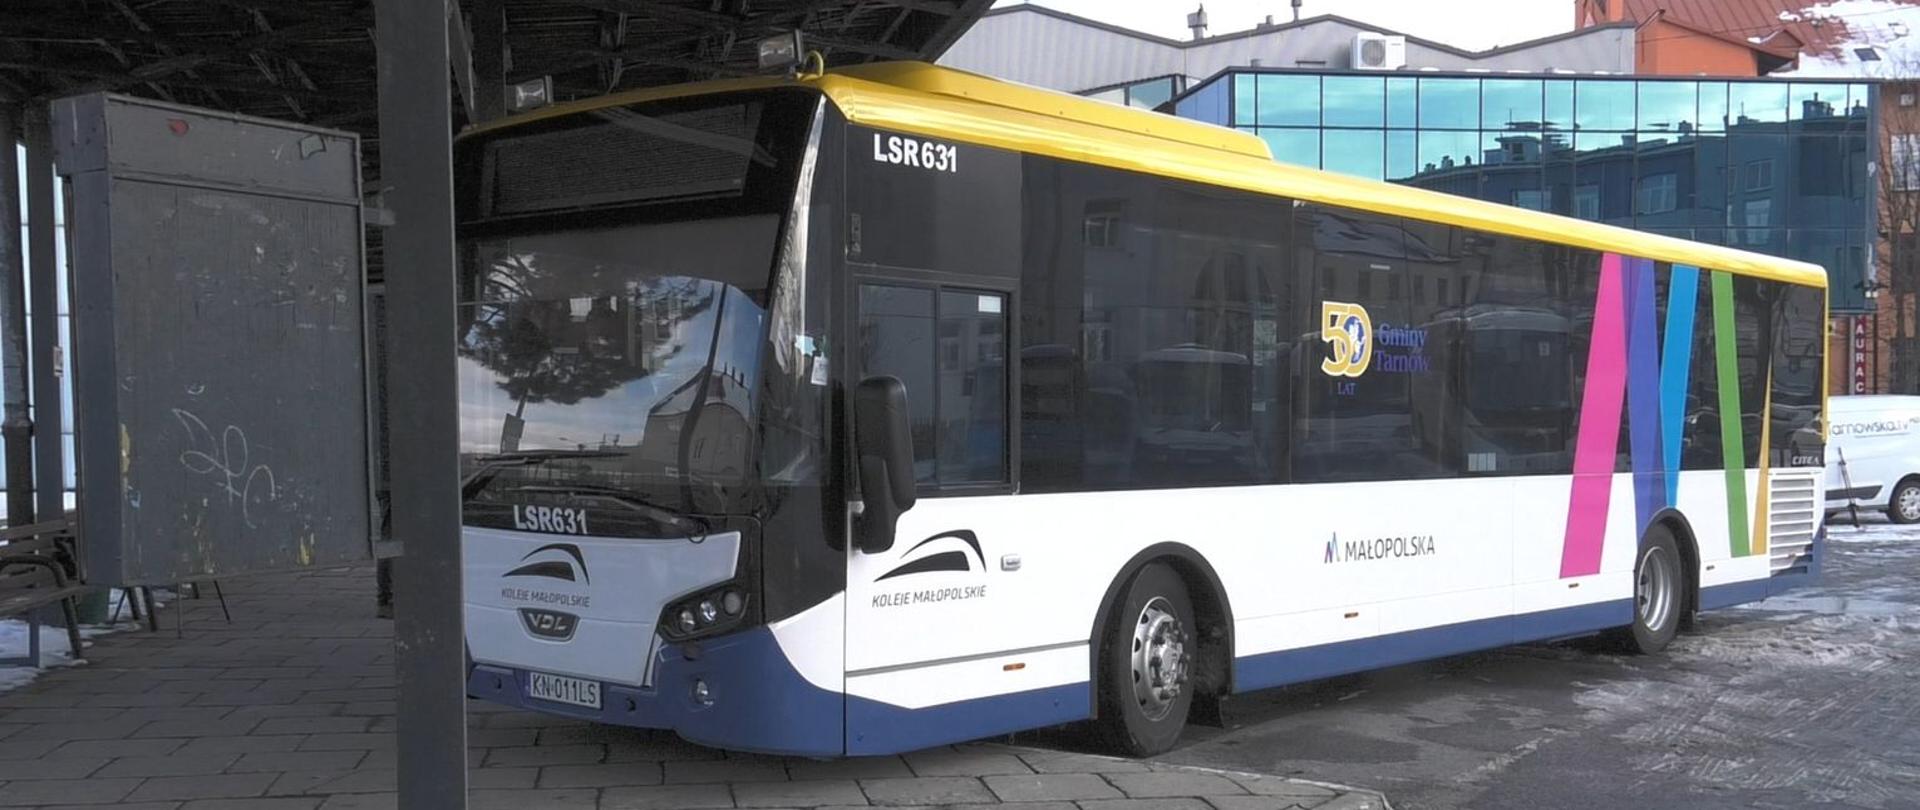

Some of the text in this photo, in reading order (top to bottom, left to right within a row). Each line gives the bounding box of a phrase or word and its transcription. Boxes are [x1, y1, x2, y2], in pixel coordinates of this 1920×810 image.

[1321, 301, 1373, 377] 50
[1378, 323, 1427, 349] Gminy
[1855, 315, 1866, 393] AURAC
[1337, 382, 1356, 395] LAT
[514, 504, 588, 535] LSR631
[1344, 535, 1436, 562] MAŁOPOLSKA
[501, 588, 590, 608] KOLEJE MAŁOPOLSKIE
[872, 585, 987, 608] KOLEJE MAŁOPOLSKIE
[528, 613, 567, 631] VDL
[532, 674, 597, 705] KN 011LS
